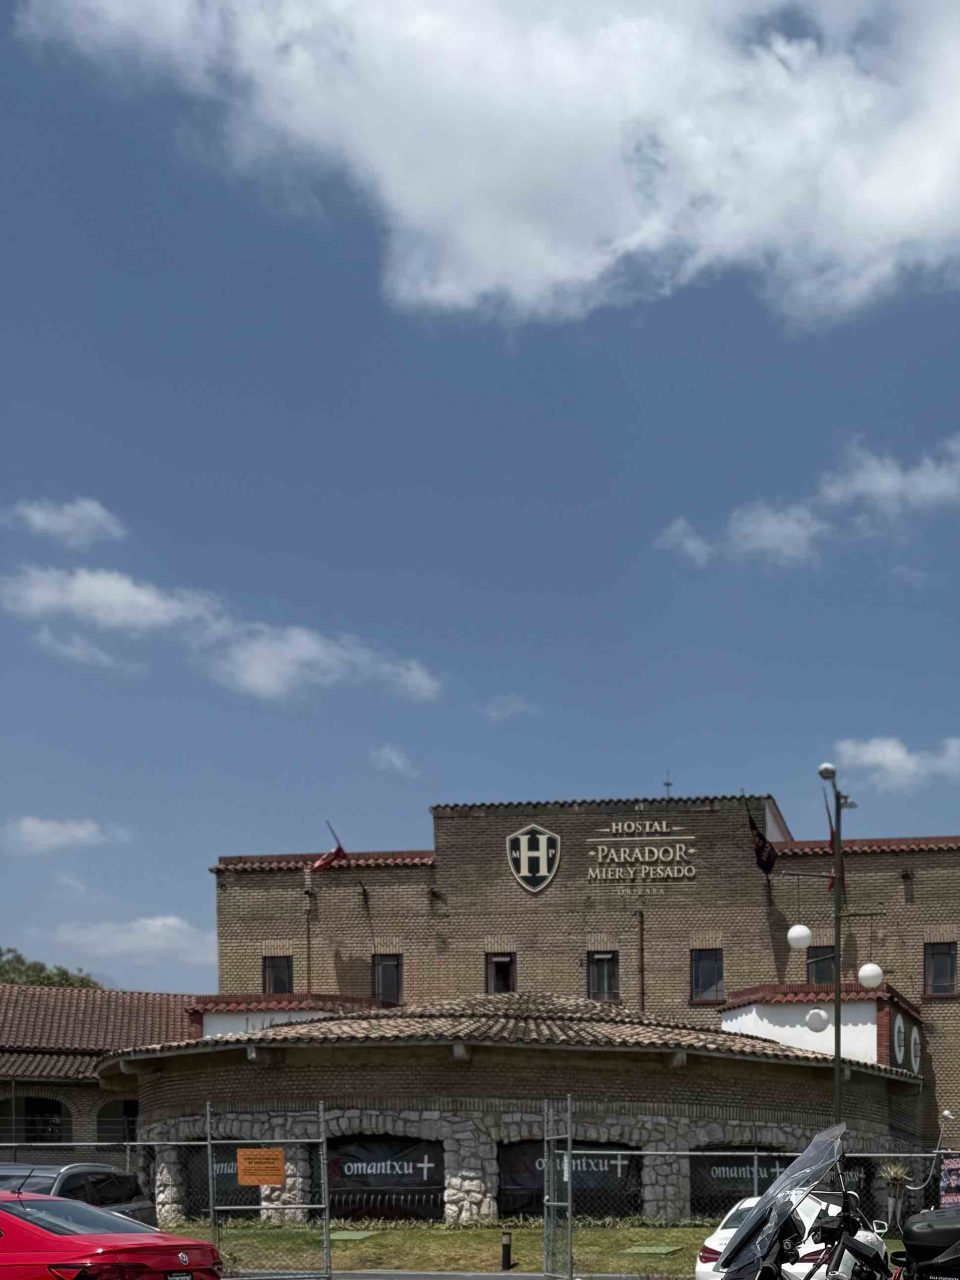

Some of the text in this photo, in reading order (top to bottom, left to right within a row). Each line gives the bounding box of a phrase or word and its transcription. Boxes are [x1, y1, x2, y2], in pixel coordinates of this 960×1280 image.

[612, 821, 671, 833] HOSTAL
[512, 834, 556, 877] M H P
[597, 844, 689, 862] PARADOR
[588, 865, 696, 880] MIER Y PESADO
[344, 1159, 414, 1175] omantxu
[535, 1156, 609, 1171] ontxu
